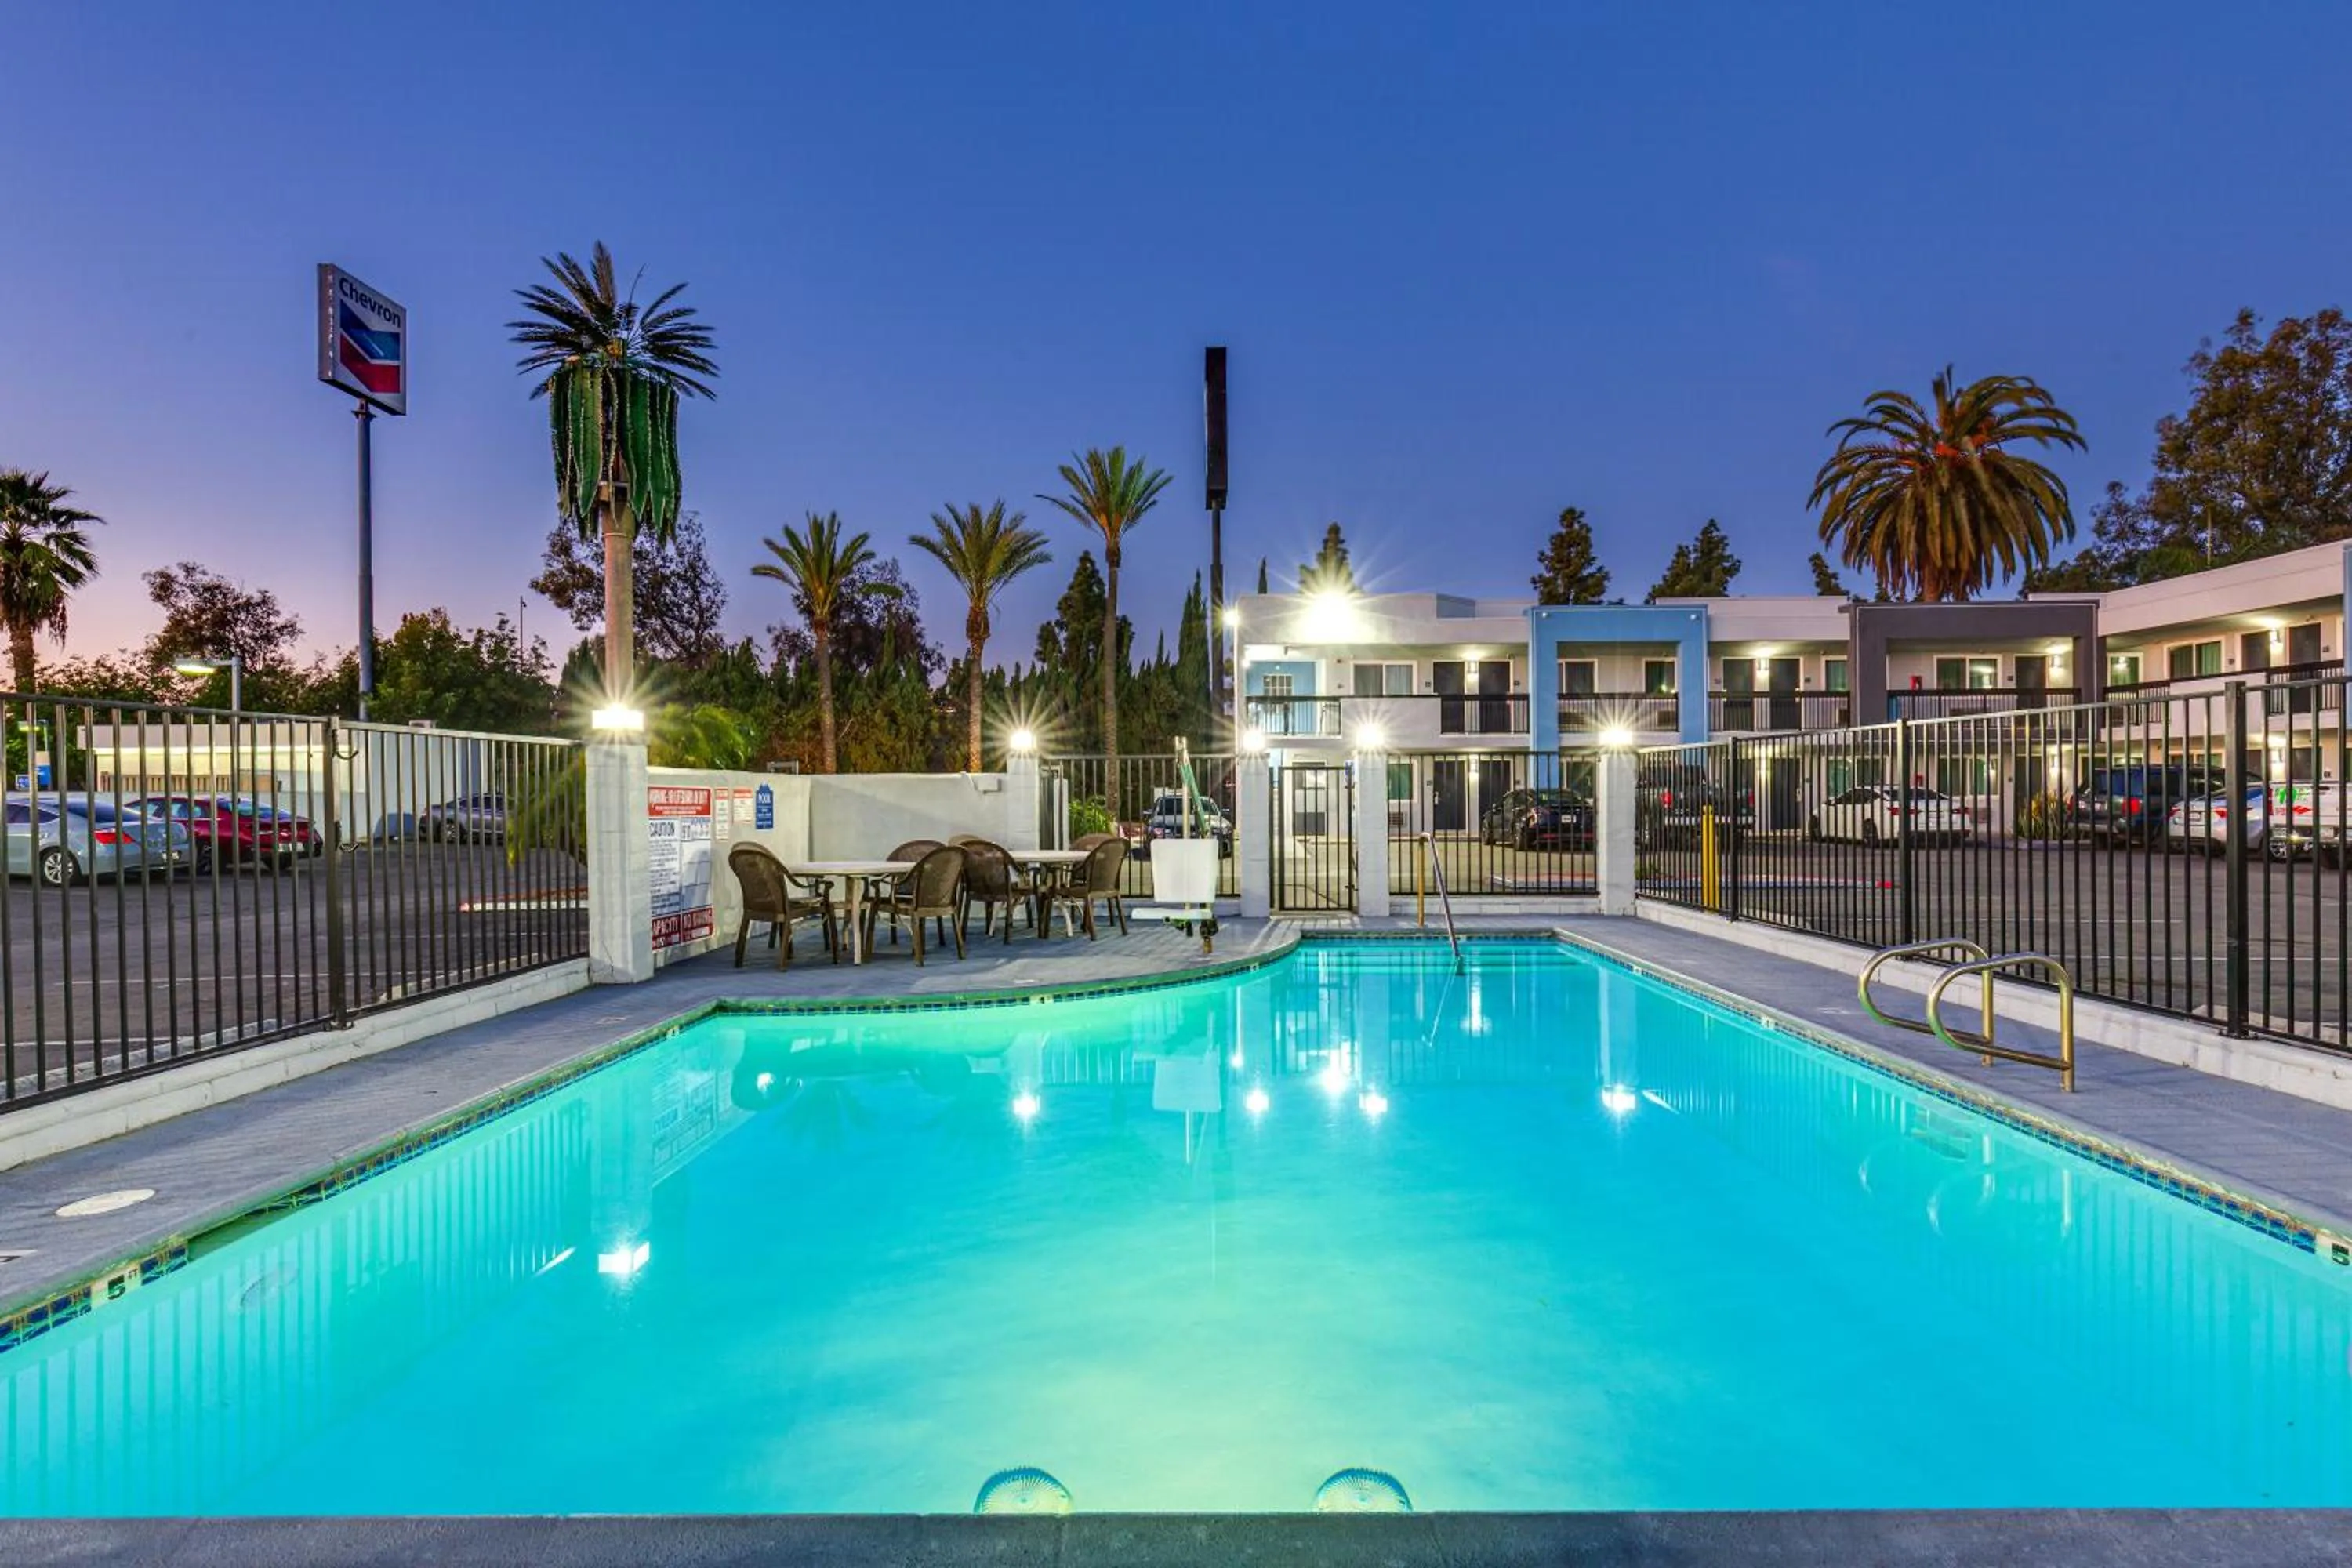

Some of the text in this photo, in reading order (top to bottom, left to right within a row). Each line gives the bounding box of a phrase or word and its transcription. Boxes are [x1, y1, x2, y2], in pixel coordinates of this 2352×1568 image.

[339, 278, 401, 328] Chevron
[2332, 1242, 2350, 1265] 5
[108, 1274, 125, 1300] 5
